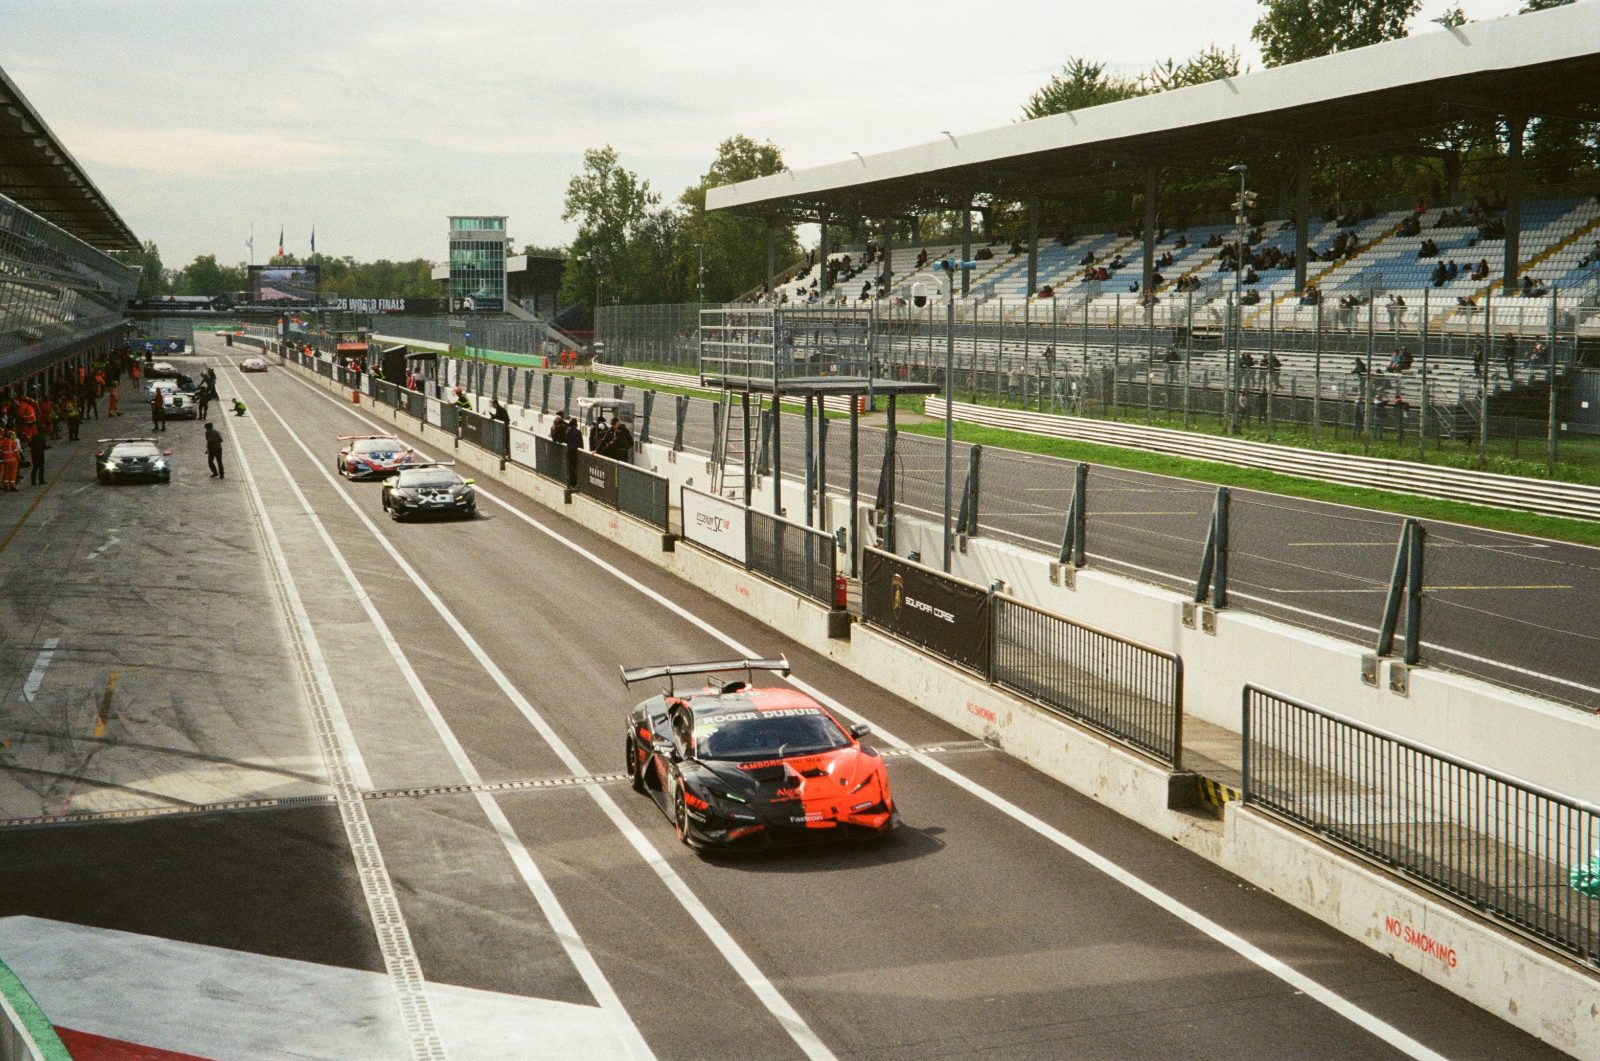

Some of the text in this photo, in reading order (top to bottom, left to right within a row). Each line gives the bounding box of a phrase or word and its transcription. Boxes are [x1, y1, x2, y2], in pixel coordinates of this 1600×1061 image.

[378, 298, 405, 310] FINALS
[905, 597, 955, 624] SQUADRA CORSE
[703, 708, 821, 724] ROGER DUBUIS
[790, 814, 824, 823] Fastron
[1385, 915, 1457, 968] NO SMOKING
